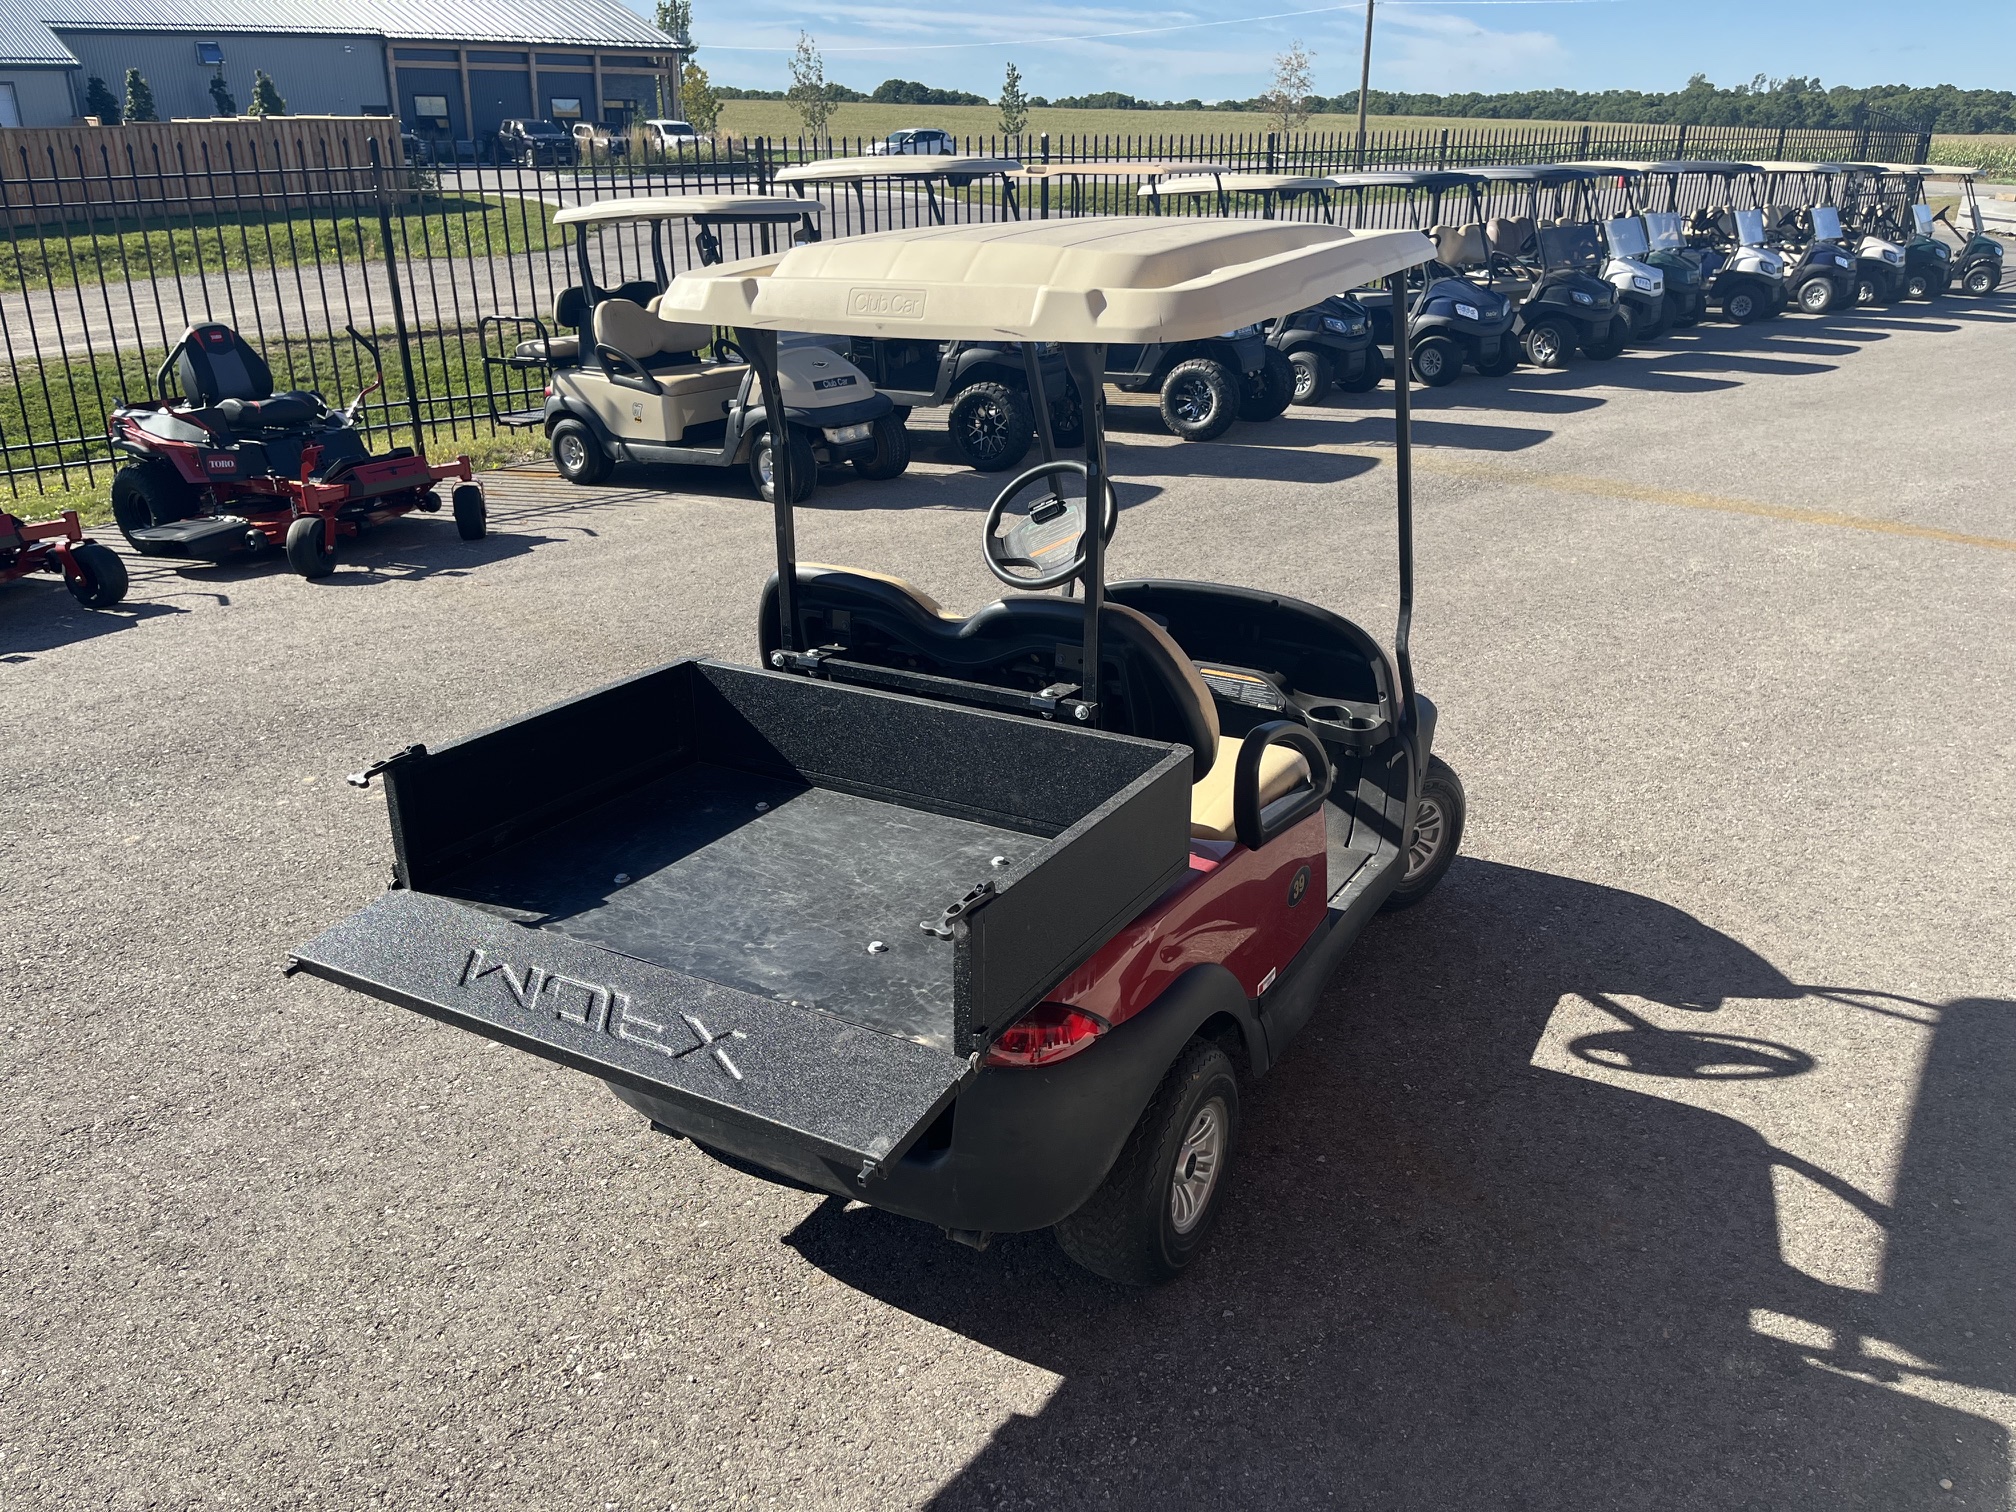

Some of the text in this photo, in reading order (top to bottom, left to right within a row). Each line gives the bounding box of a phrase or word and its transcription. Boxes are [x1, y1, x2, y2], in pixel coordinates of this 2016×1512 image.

[854, 293, 920, 315] Club Car
[822, 380, 837, 389] Club
[208, 460, 235, 468] TORO
[1293, 873, 1305, 900] 39
